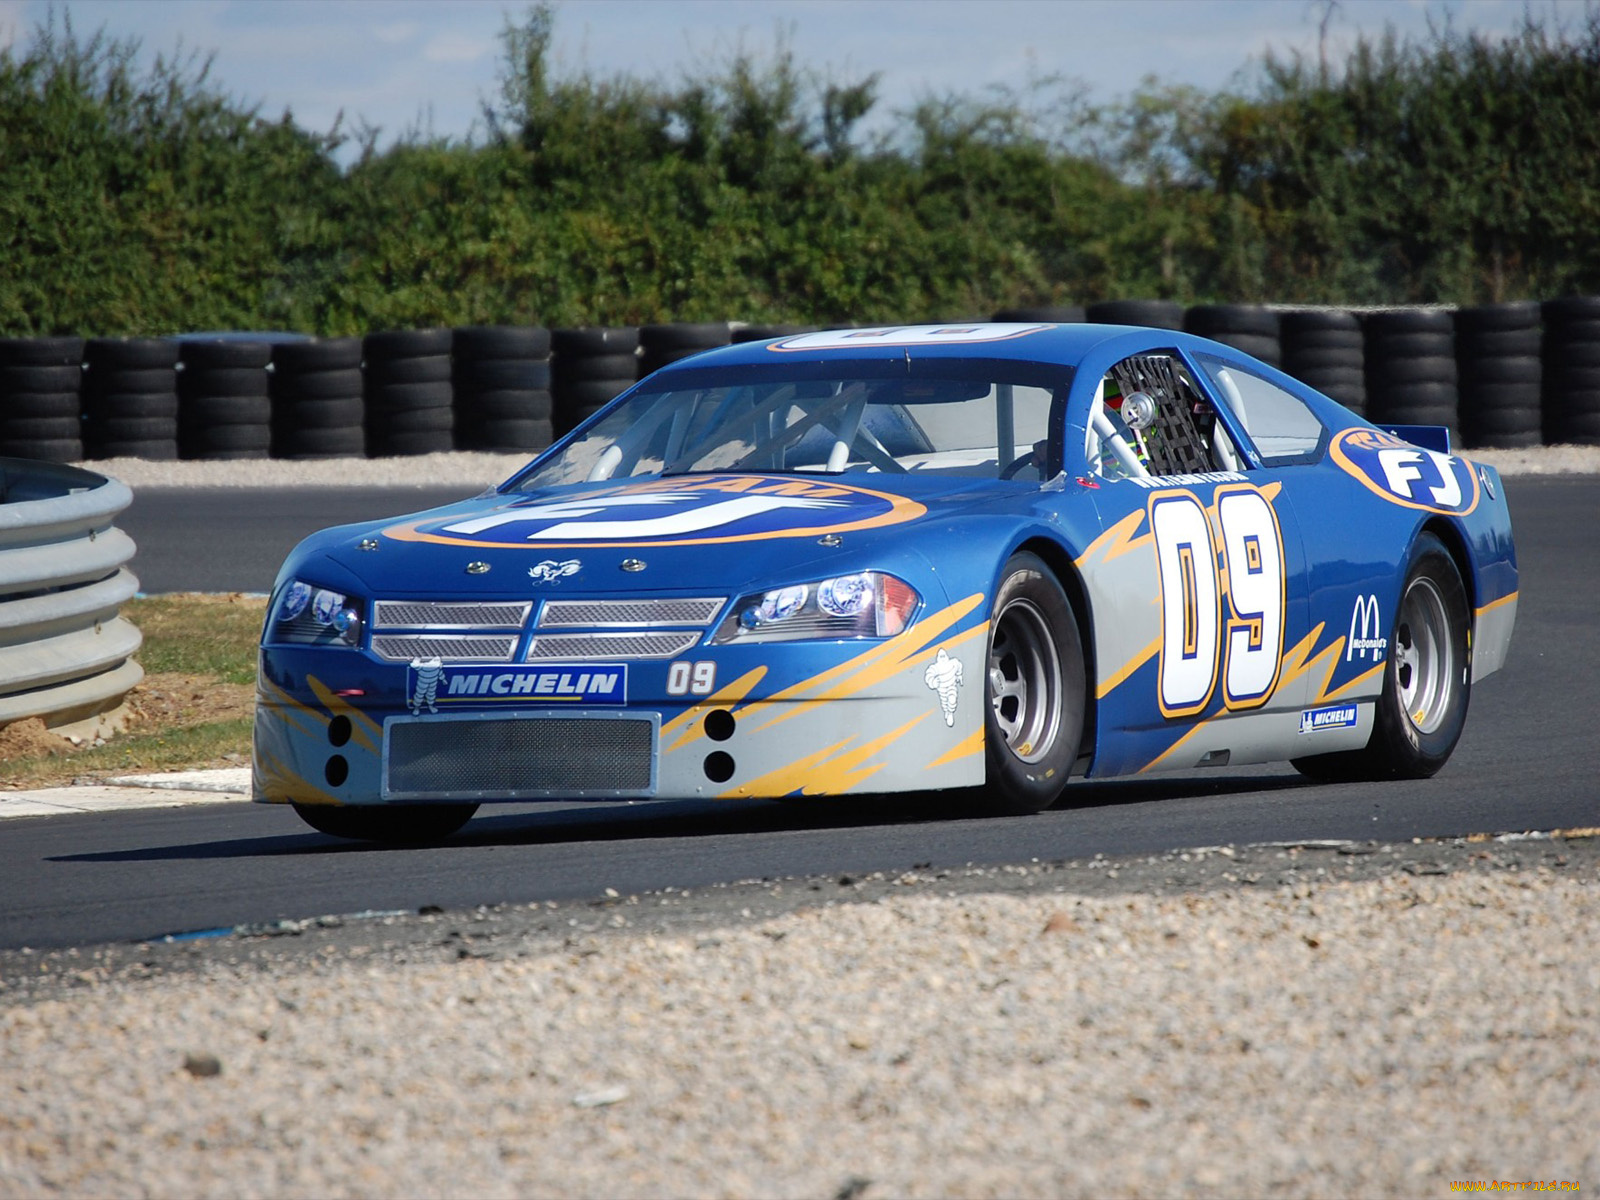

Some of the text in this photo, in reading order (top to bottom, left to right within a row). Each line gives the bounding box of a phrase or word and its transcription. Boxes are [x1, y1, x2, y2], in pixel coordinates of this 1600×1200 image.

[1378, 449, 1462, 507] FJ
[1150, 486, 1286, 716] 09
[448, 672, 619, 696] MICHELIN
[666, 660, 718, 696] 09
[1313, 708, 1356, 726] MICHELIN
